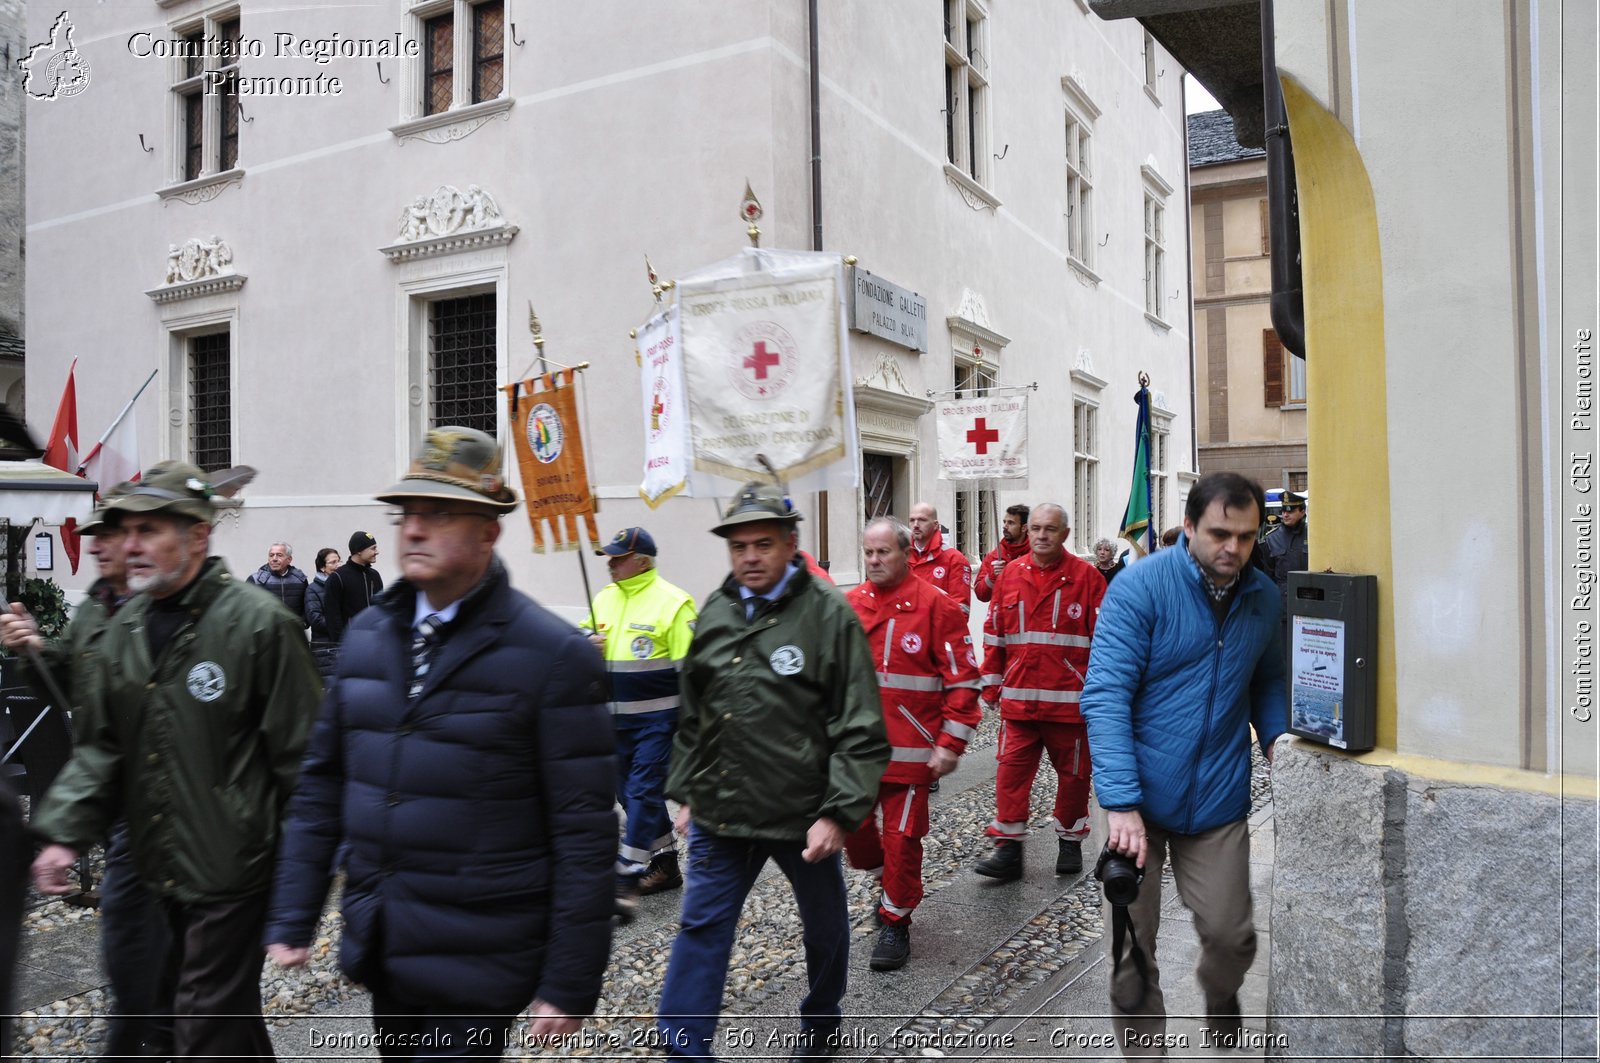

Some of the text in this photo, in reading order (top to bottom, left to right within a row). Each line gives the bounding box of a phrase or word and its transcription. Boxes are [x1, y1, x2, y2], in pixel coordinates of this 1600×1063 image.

[857, 277, 926, 321] FONDAZIONE GALLETTI
[872, 311, 915, 338] PALAZZO SILVA
